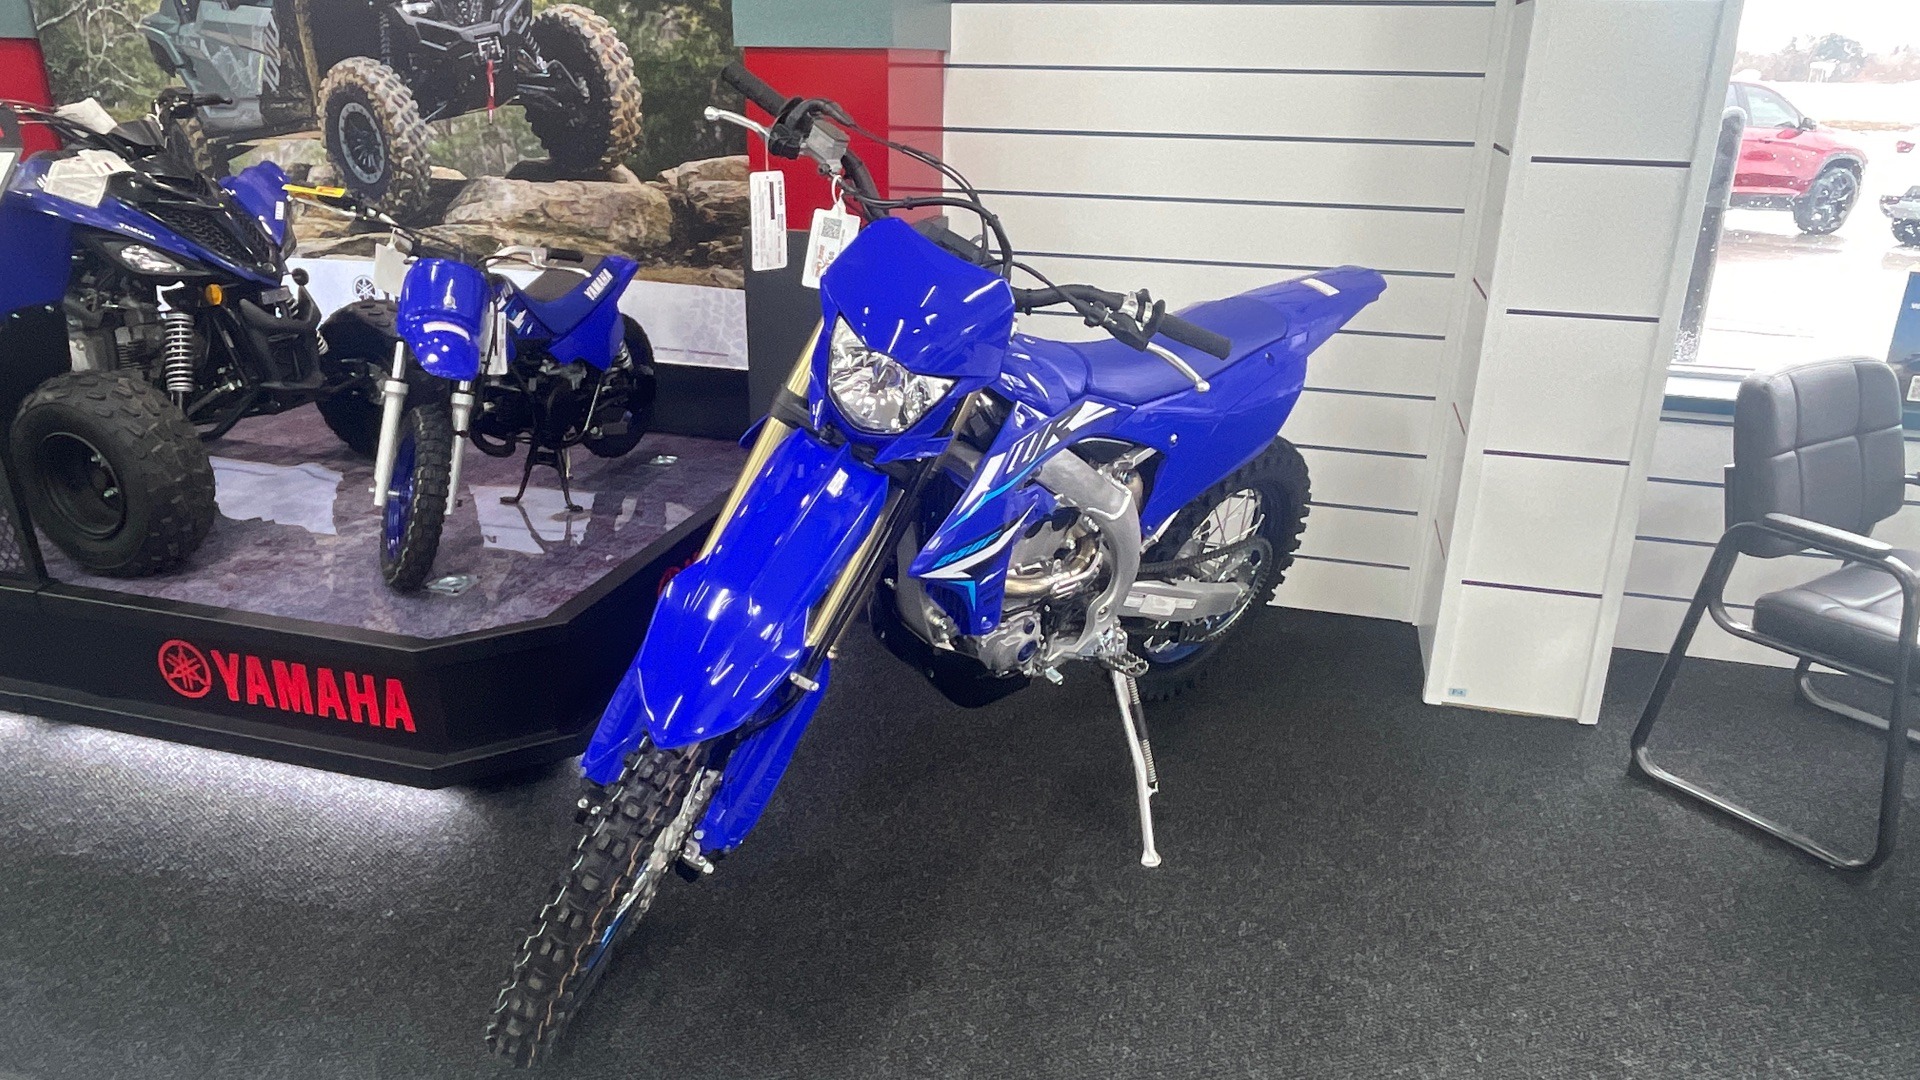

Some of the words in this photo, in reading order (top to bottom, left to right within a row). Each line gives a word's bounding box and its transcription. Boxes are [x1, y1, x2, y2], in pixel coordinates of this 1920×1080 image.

[119, 222, 156, 240] YAMAHA
[583, 268, 614, 301] YAMAHA
[931, 529, 1003, 569] 250F
[210, 649, 417, 732] YAMAHA
